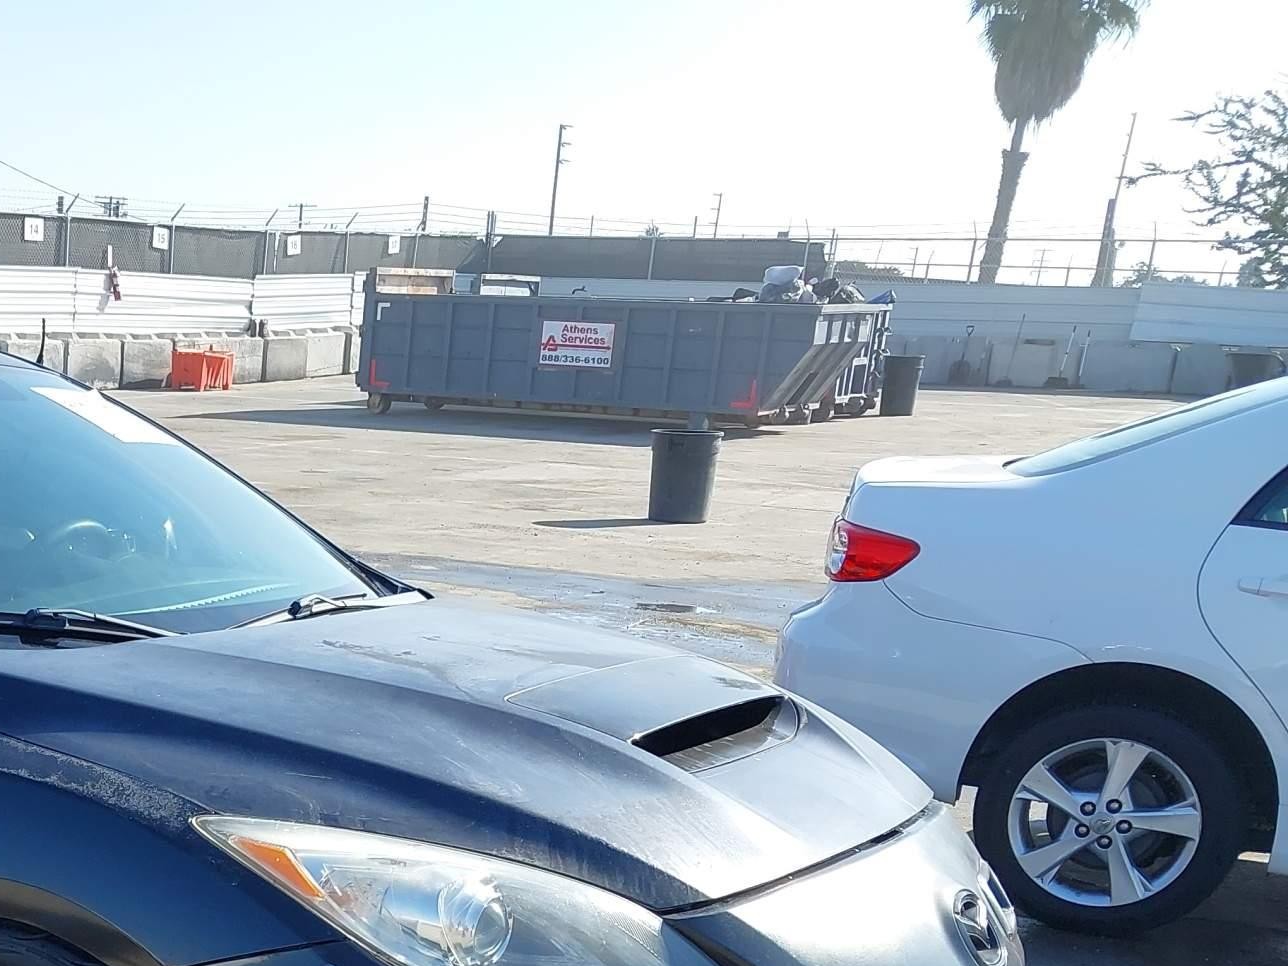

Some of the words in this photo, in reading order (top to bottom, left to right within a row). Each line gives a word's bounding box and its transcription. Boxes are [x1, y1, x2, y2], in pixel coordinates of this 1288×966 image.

[30, 223, 39, 235] 14
[158, 232, 166, 244] 15
[562, 324, 599, 335] Athens
[560, 333, 606, 345] Services
[541, 354, 609, 365] 888/336-6100
